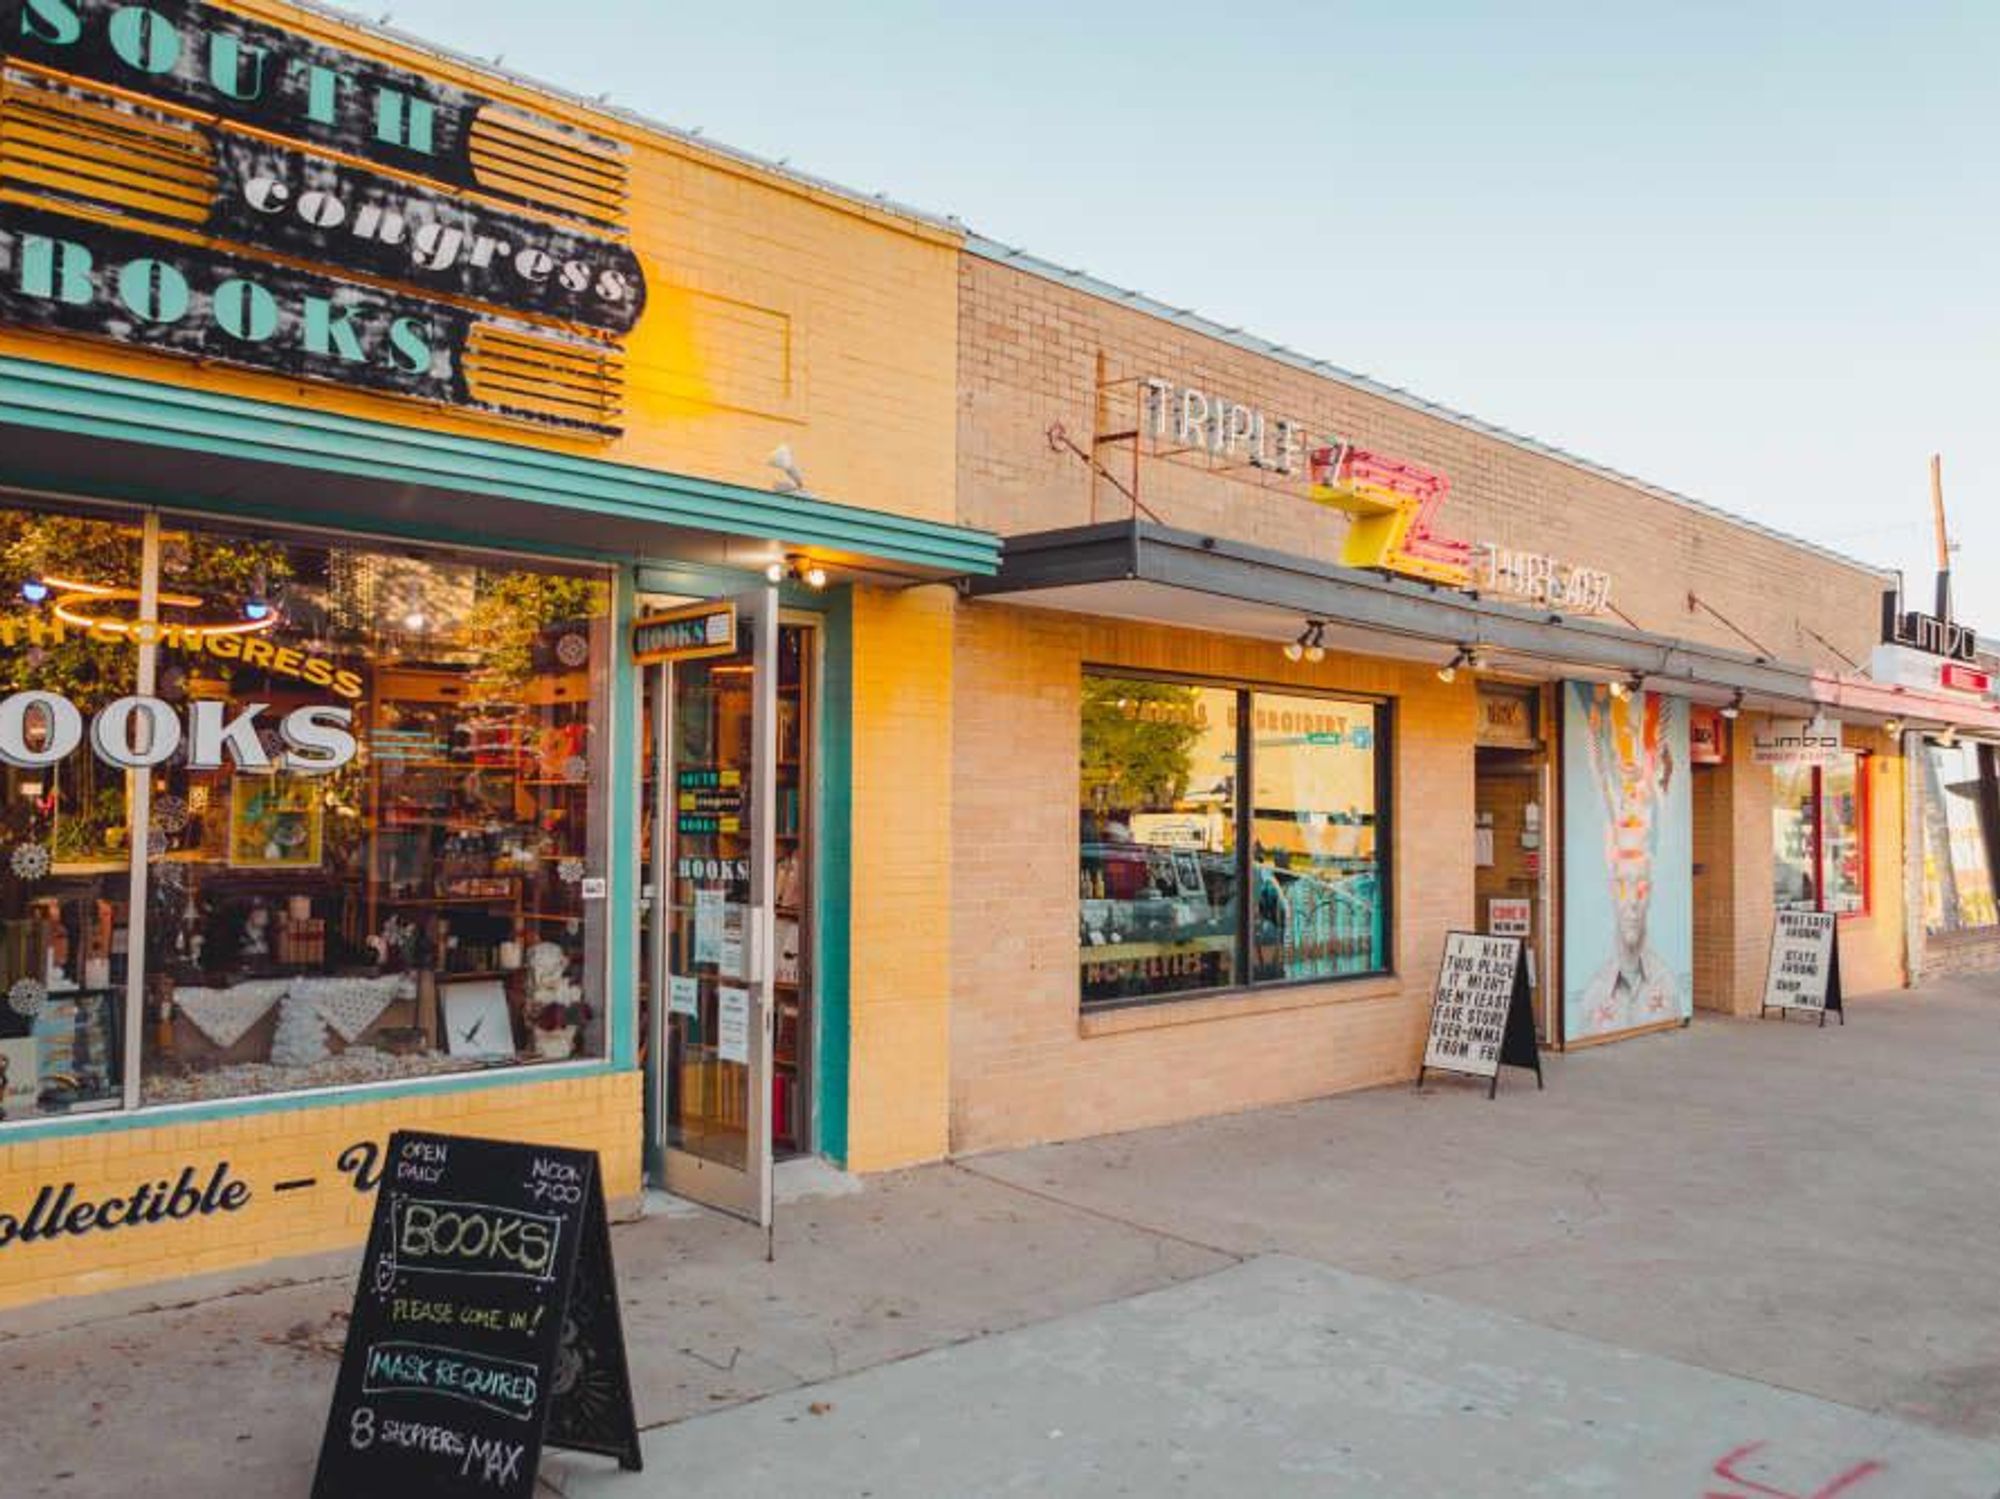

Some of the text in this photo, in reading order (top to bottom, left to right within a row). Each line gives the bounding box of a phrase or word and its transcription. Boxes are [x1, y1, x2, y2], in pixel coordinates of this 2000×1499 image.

[20, 0, 435, 156] SOUTH
[244, 176, 628, 302] congress
[19, 232, 433, 376] BOOKS
[1143, 377, 1301, 477] TRIPLE
[88, 620, 363, 698] CONGRESS
[0, 690, 357, 776] OOKS
[1478, 959, 1514, 979] PLACE
[402, 1141, 447, 1164] OPEN
[402, 1203, 551, 1270] BOOKS
[391, 1299, 454, 1323] PLEASE
[460, 1307, 502, 1331] COME
[369, 1350, 433, 1385] MASK
[350, 1406, 376, 1450] 8
[459, 1435, 525, 1488] MAX
